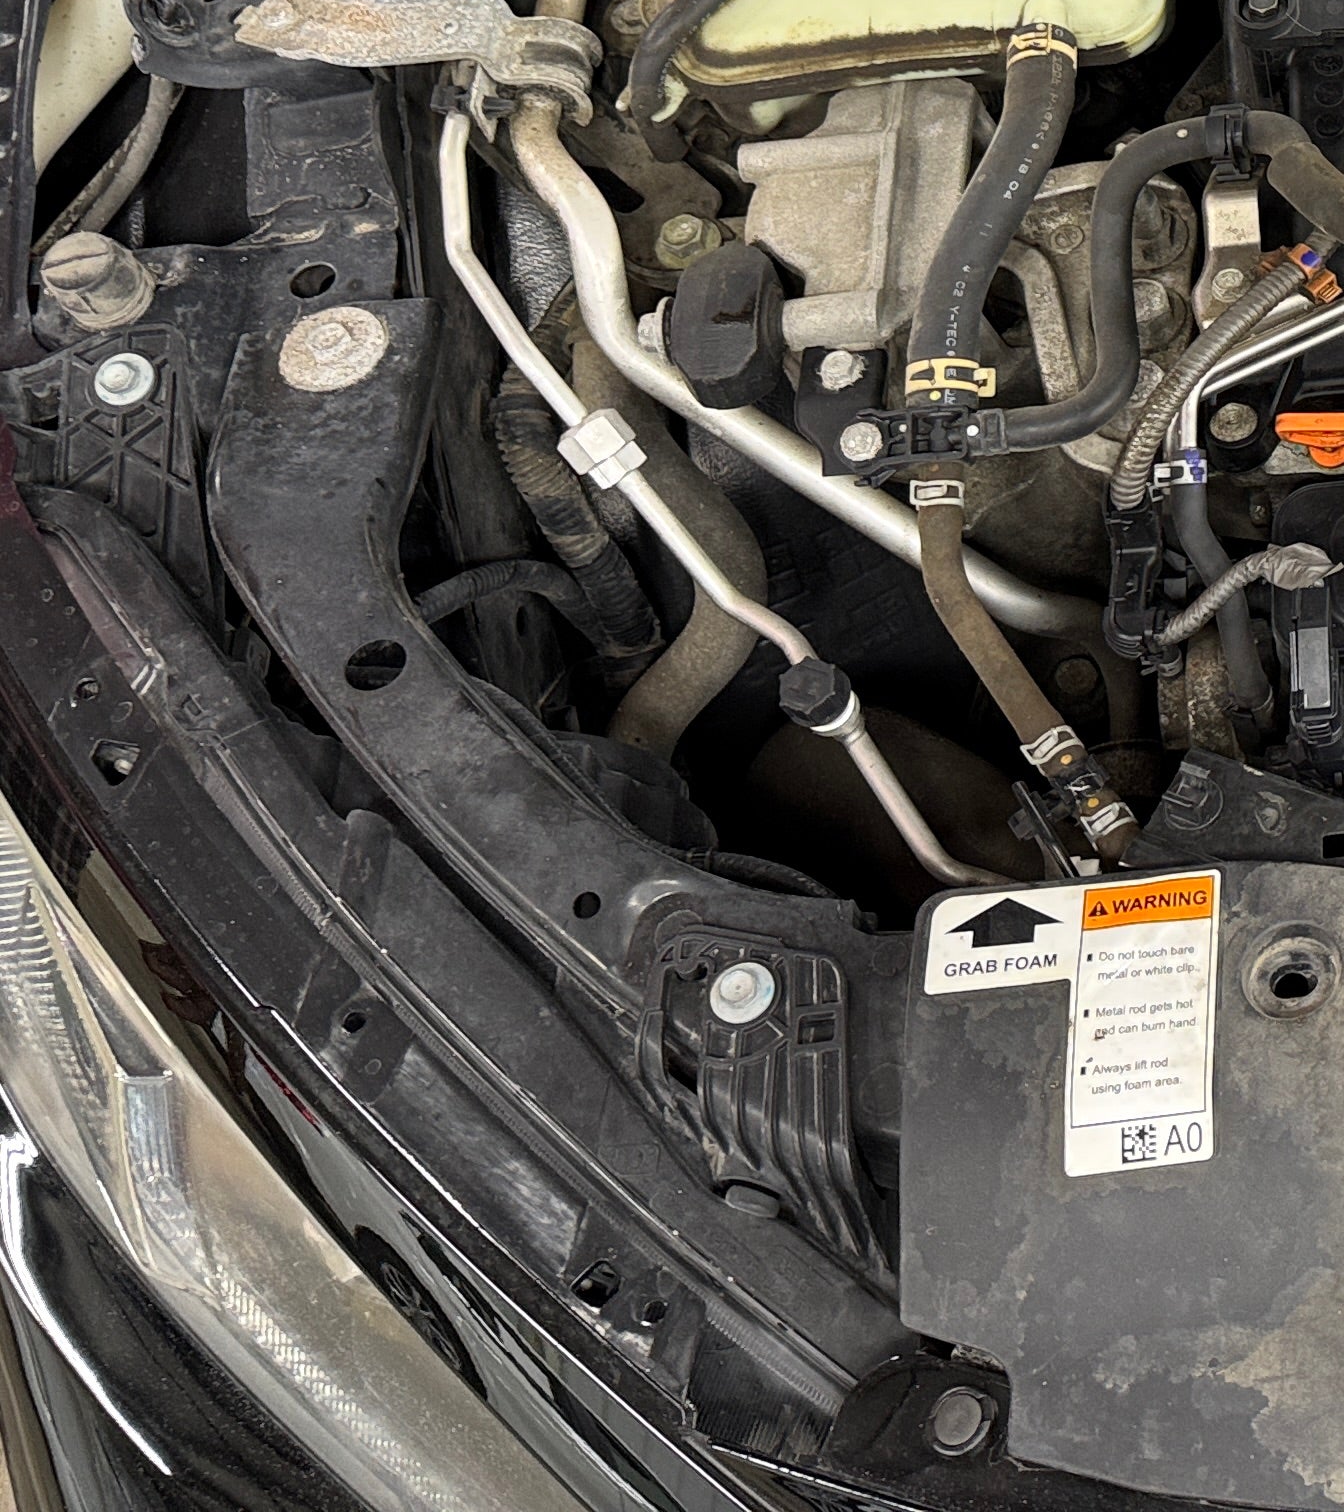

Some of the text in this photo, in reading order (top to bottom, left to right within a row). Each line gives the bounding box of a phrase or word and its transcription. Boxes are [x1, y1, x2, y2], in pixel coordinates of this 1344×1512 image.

[946, 281, 966, 347] C2 Y-TEC
[1112, 890, 1208, 914] WARNING
[1098, 945, 1195, 962] Do not touch bare
[944, 953, 1058, 978] GRAB FOAM
[1131, 969, 1142, 977] or
[1144, 965, 1173, 977] white
[1095, 998, 1193, 1018] Metal rod gets hot
[1118, 1024, 1138, 1035] can
[1092, 1057, 1169, 1076] Always lift rod
[1091, 1076, 1183, 1095] using foam area.
[1163, 1121, 1203, 1157] A0
